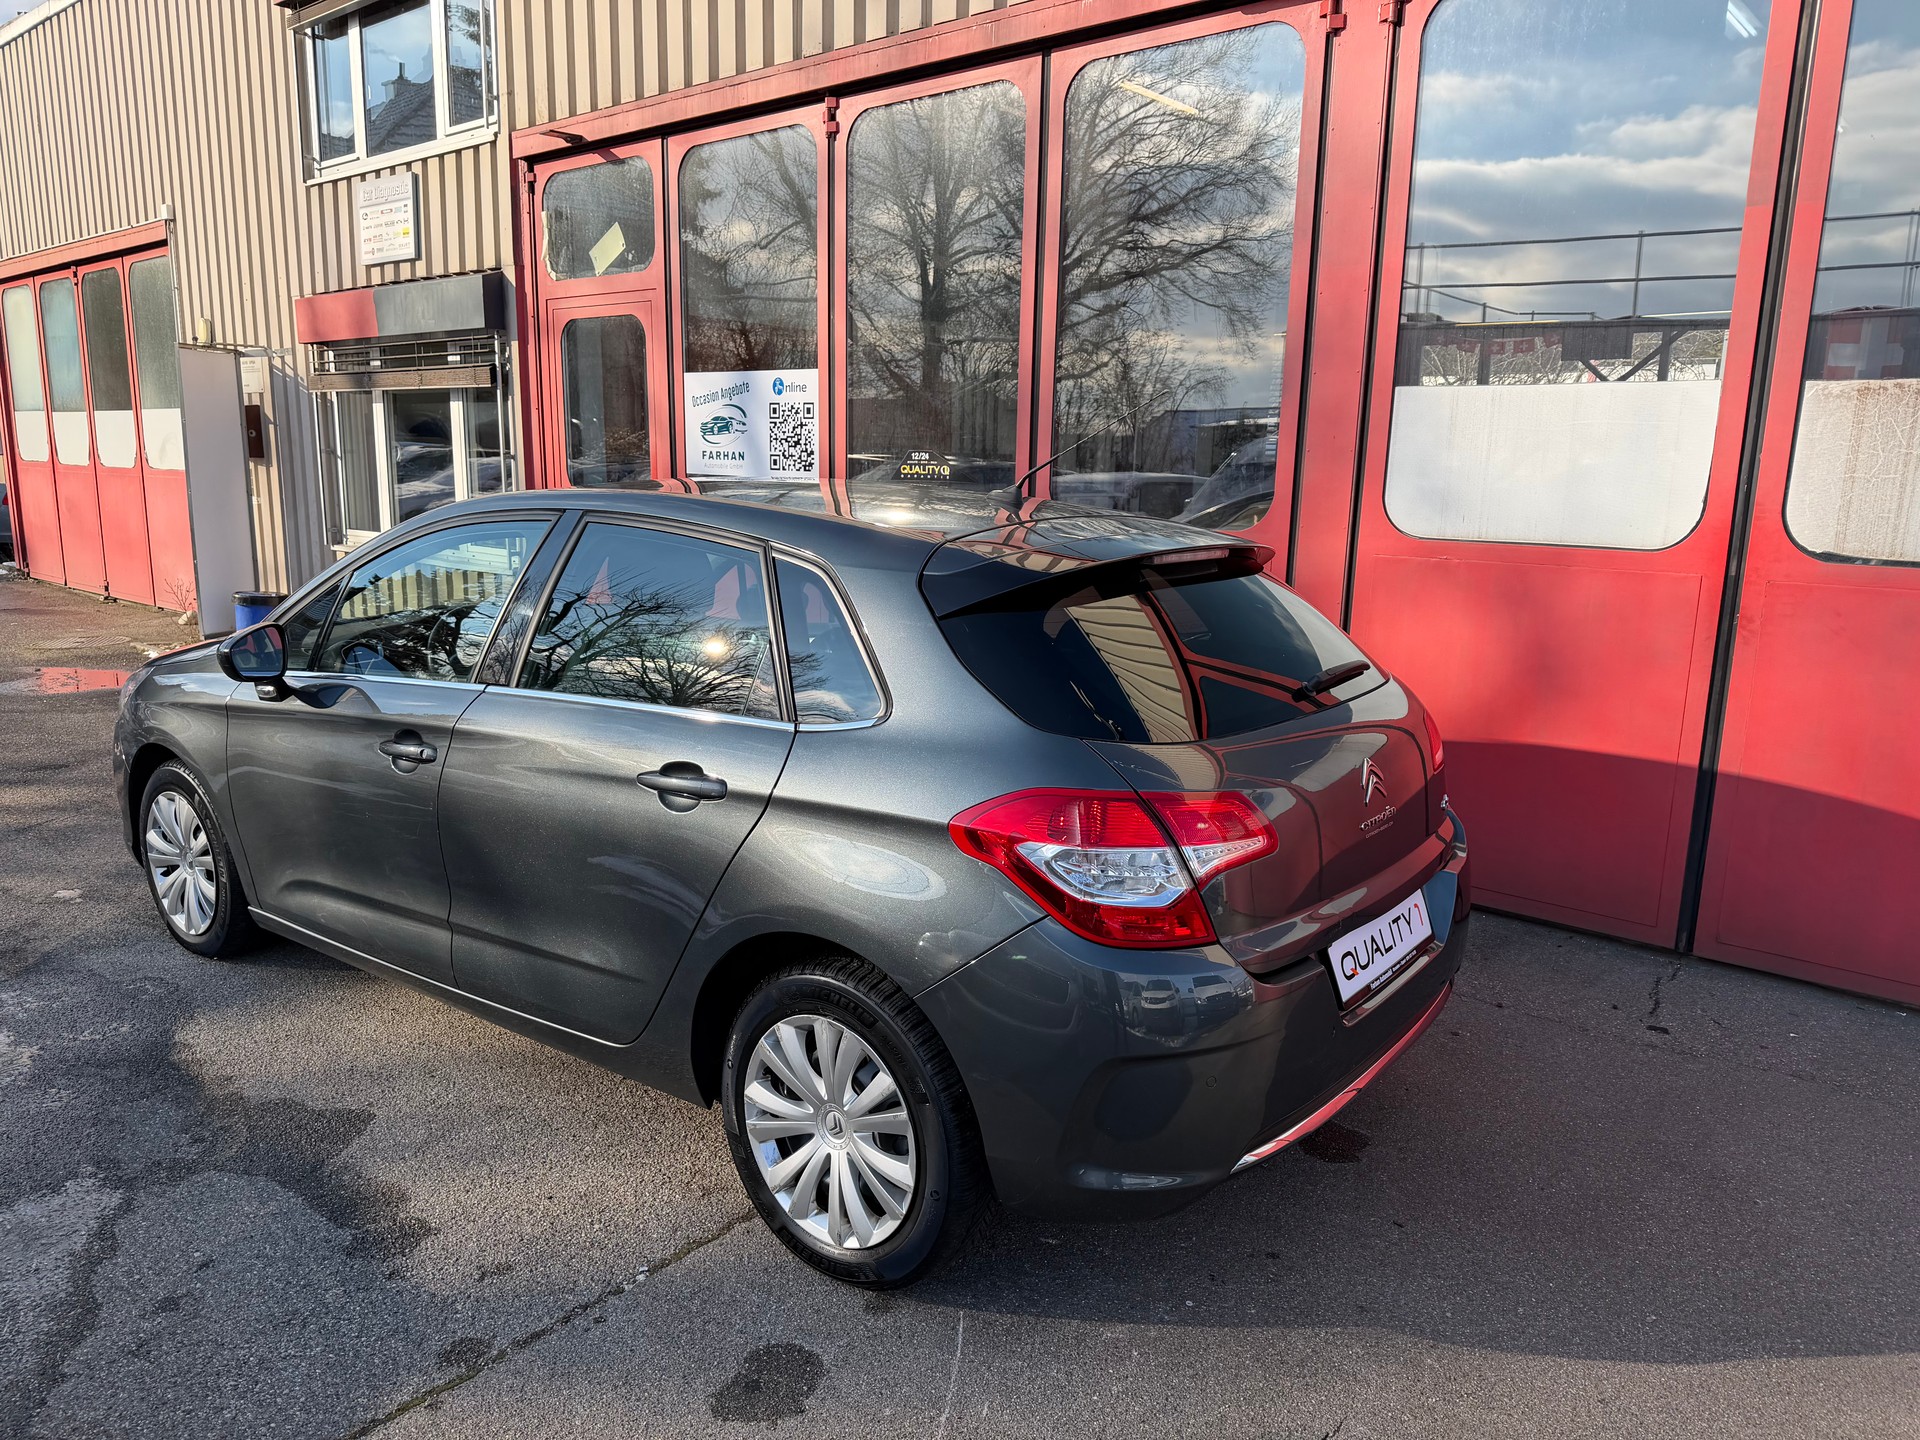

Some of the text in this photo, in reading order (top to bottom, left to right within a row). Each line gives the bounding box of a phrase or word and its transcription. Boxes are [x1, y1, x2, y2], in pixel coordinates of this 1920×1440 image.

[363, 188, 373, 202] Car
[691, 381, 750, 408] Occasion Angebote
[702, 450, 745, 461] FARHAN
[911, 452, 929, 460] 12/24
[900, 465, 940, 475] QUALITY
